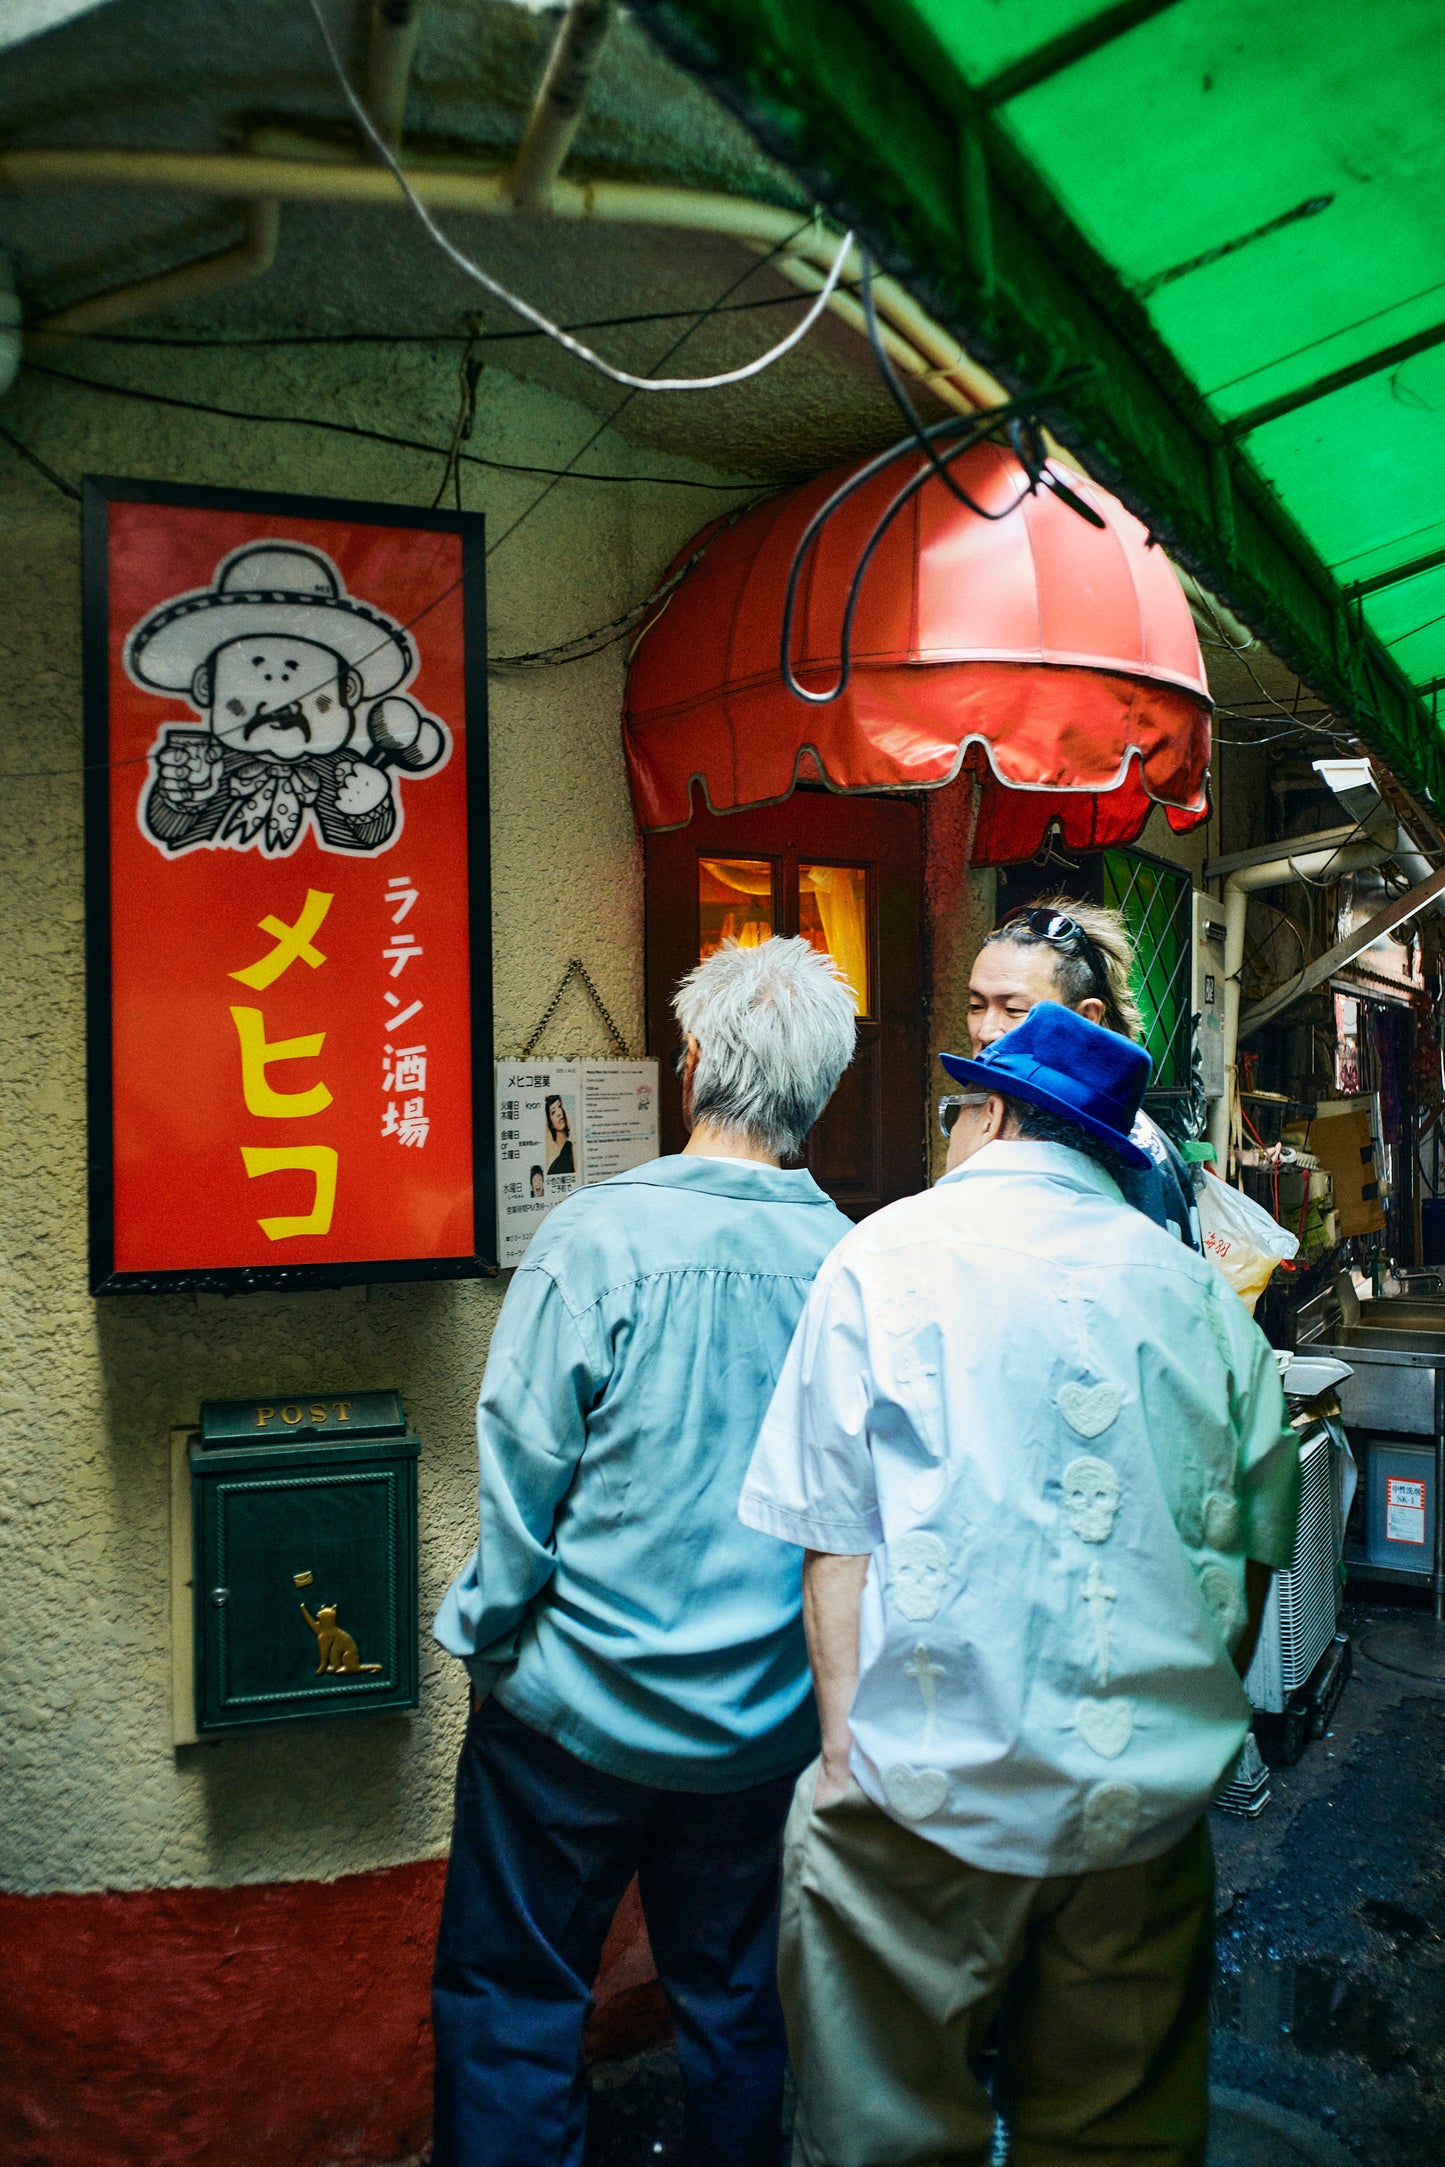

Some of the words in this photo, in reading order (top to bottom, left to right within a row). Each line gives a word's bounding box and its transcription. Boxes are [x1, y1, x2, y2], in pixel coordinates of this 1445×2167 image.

[381, 875, 430, 1148] ラテン酒場
[227, 888, 339, 1241] メヒコ
[508, 1075, 551, 1087] メヒコ営業
[500, 1130, 519, 1140] 金曜日
[501, 1149, 520, 1160] 土曜日
[255, 1402, 353, 1427] POST
